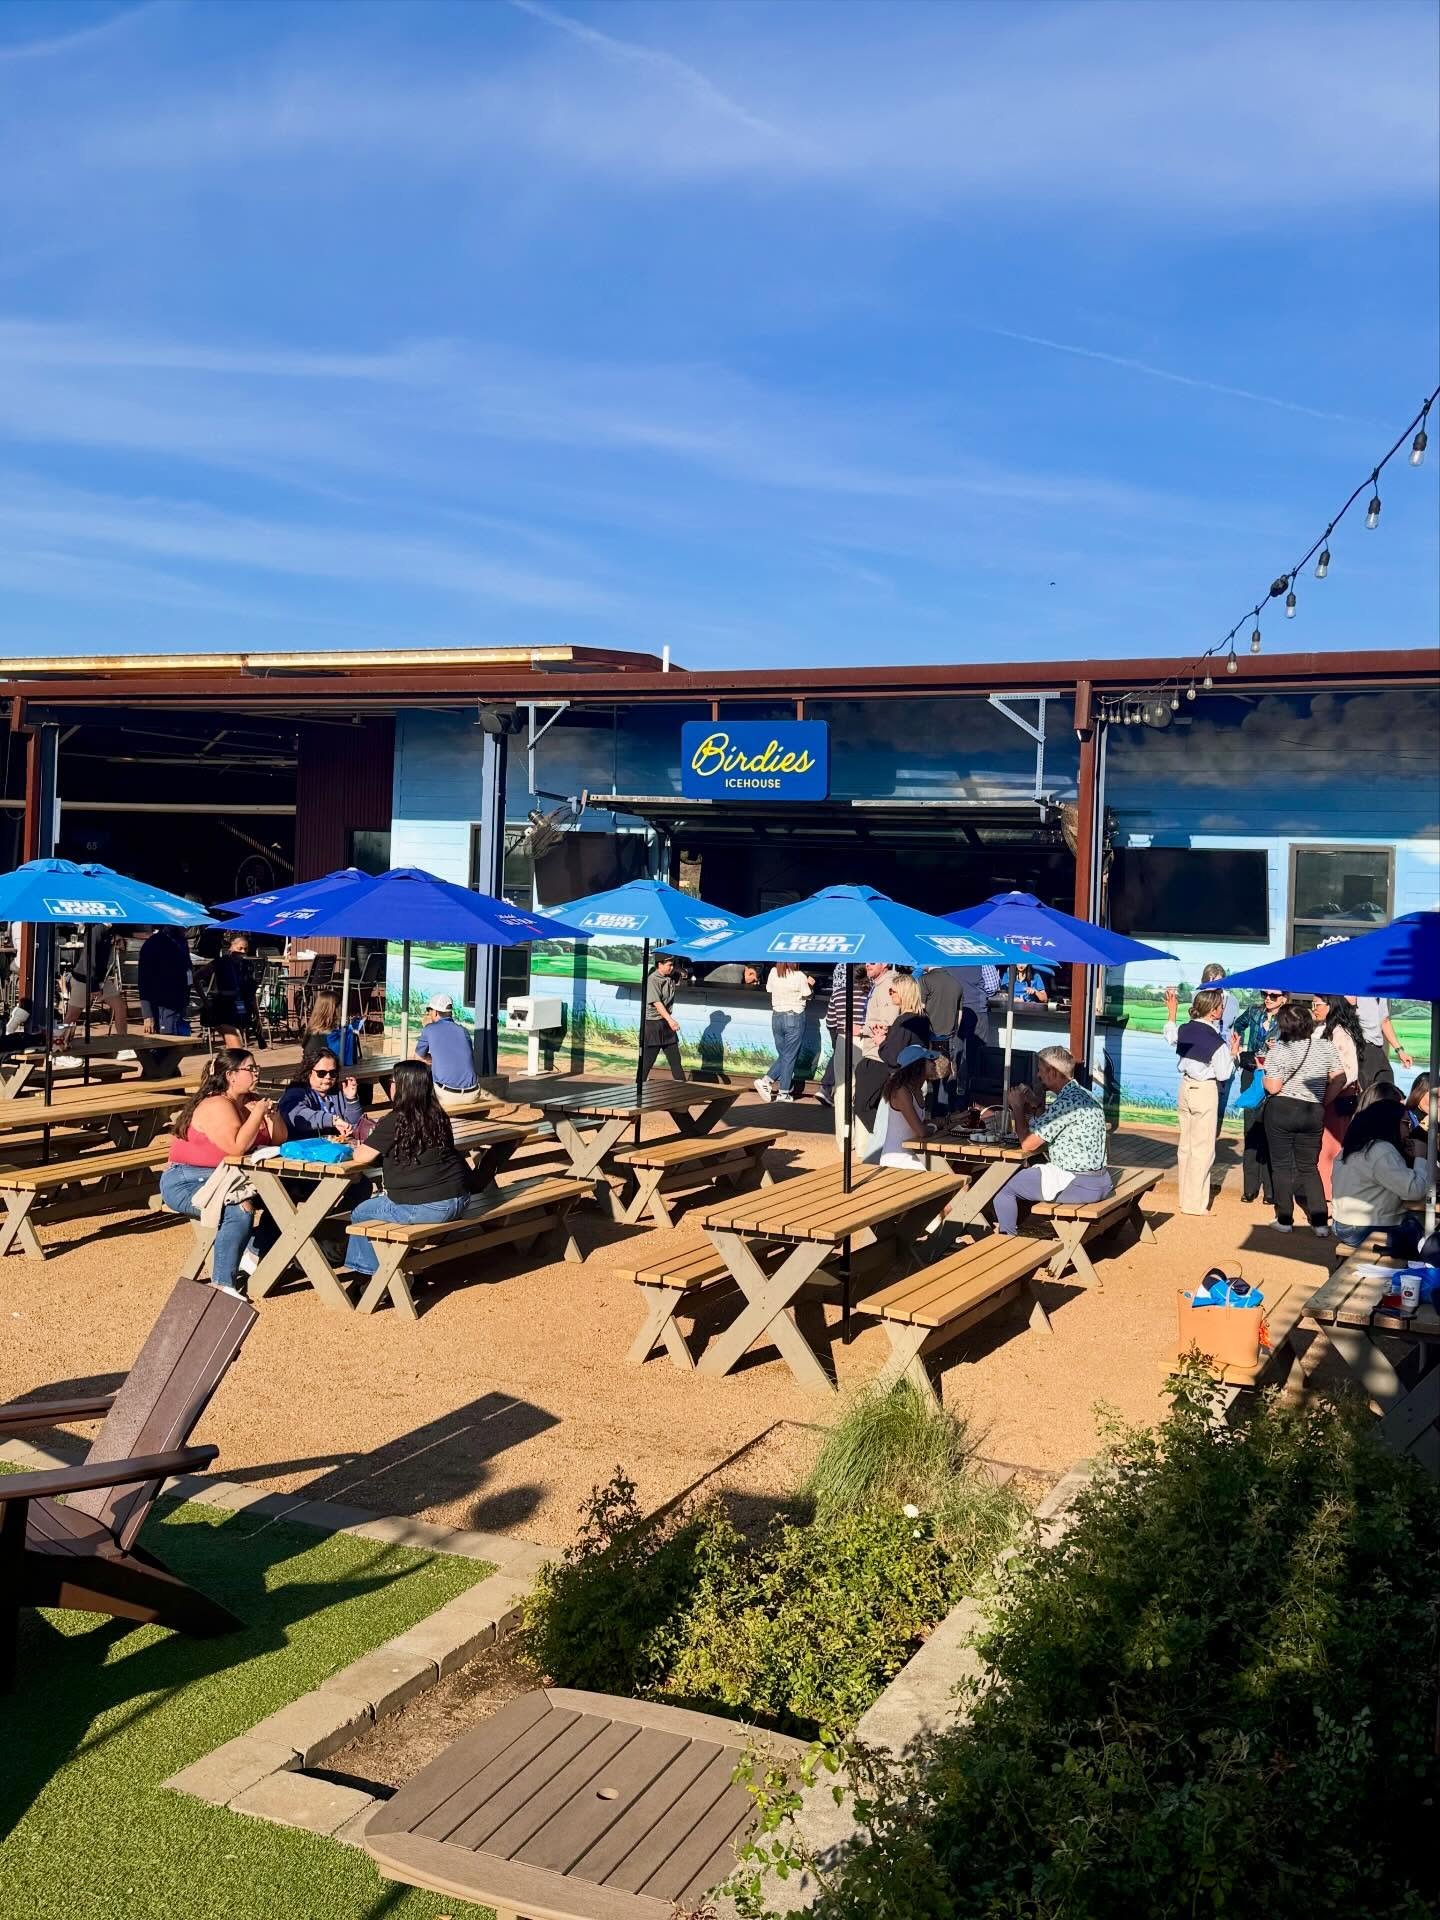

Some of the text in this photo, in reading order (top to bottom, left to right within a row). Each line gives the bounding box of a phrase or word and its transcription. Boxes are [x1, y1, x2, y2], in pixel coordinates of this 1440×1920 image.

[691, 732, 816, 776] Birdies
[725, 778, 781, 789] ICEHOUSE
[57, 900, 107, 909] BUD
[584, 918, 640, 929] LIGHT
[596, 914, 637, 923] BUD
[789, 934, 848, 944] BUD
[774, 942, 854, 953] LIGHT
